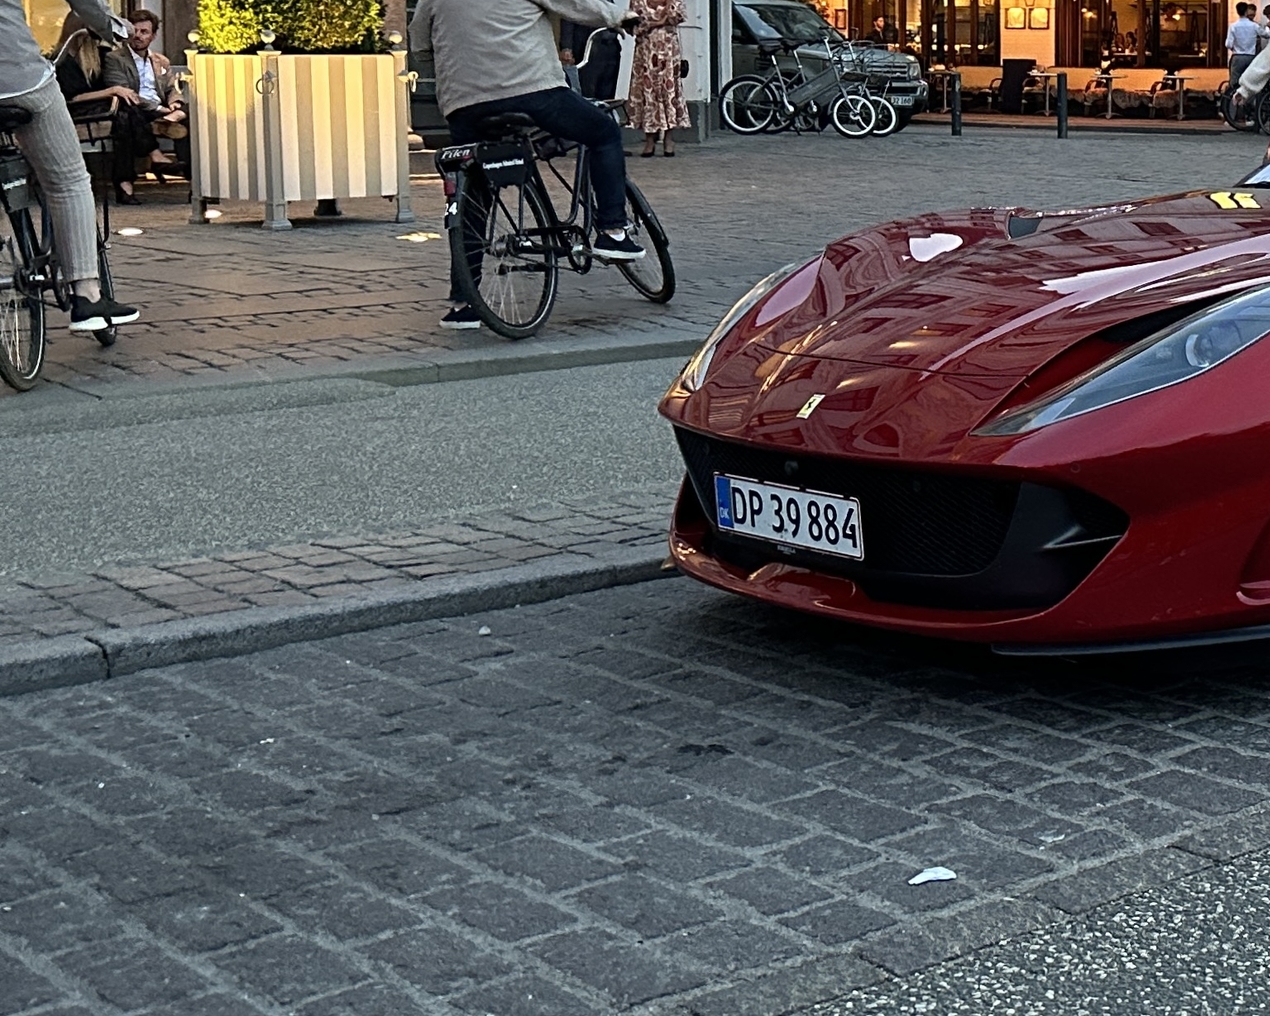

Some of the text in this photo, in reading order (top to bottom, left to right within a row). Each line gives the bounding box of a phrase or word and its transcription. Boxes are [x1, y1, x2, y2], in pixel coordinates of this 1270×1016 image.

[719, 506, 730, 519] DK
[732, 486, 857, 548] DP 39 884
